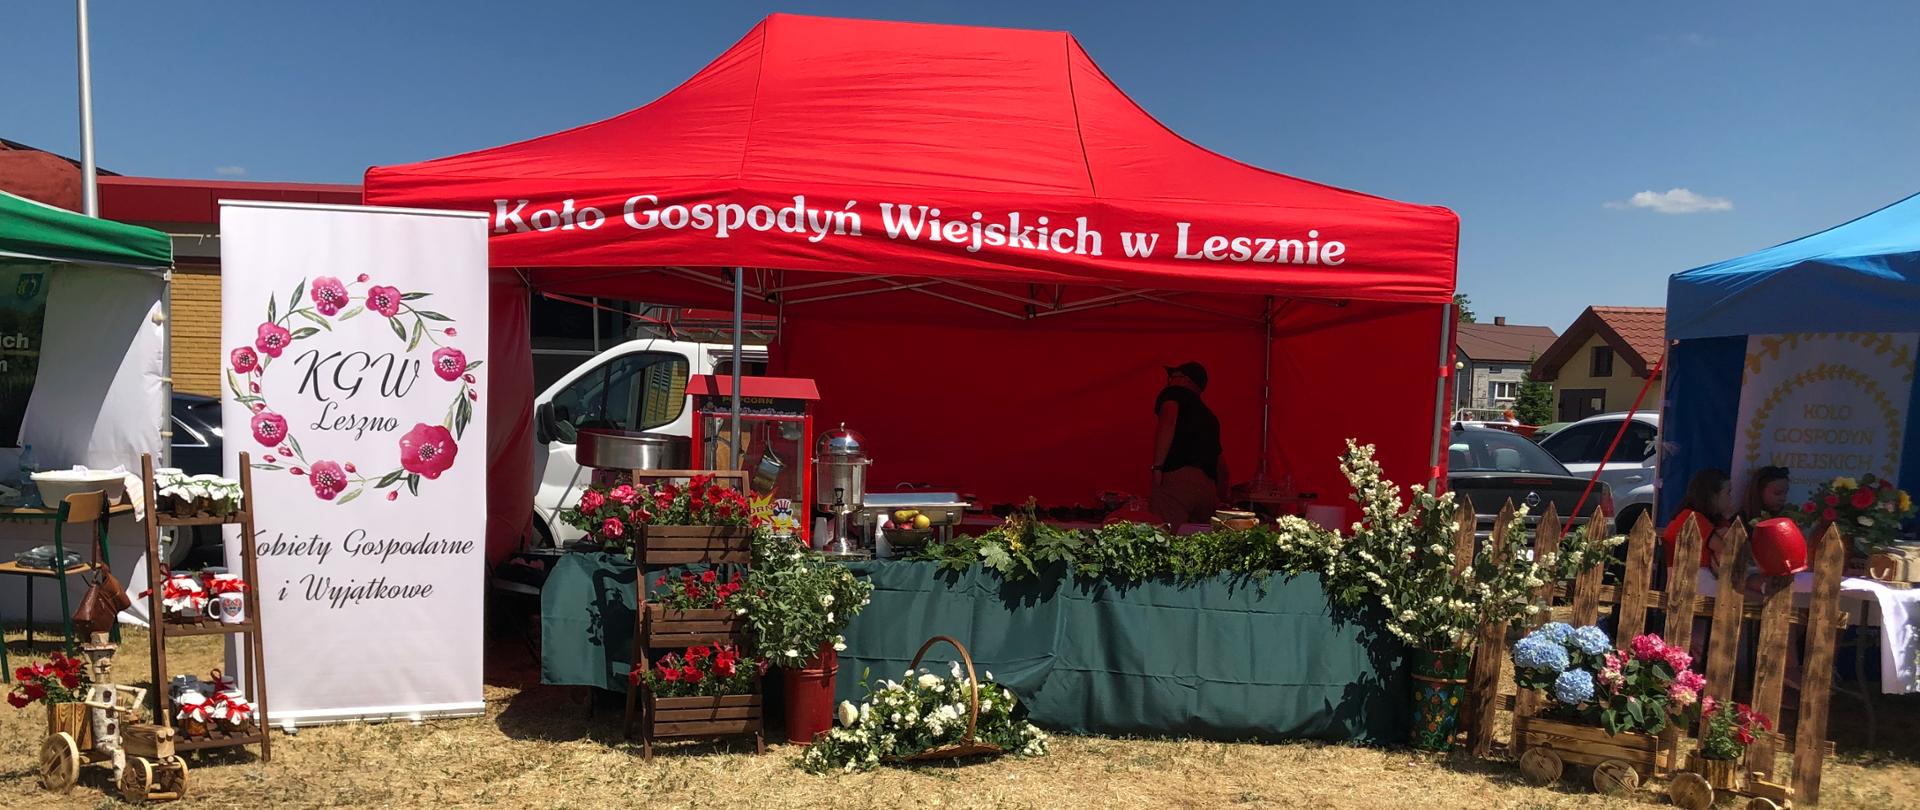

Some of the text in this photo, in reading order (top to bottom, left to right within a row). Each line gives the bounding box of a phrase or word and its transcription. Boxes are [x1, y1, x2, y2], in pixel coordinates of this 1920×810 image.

[494, 194, 1346, 266] Koło Gospodyń Wiejskich w Lesznie
[294, 349, 421, 402] KGW
[310, 401, 400, 441] Leszno
[343, 528, 475, 564] Gospodarne
[278, 573, 434, 609] i Wyjątkowe
